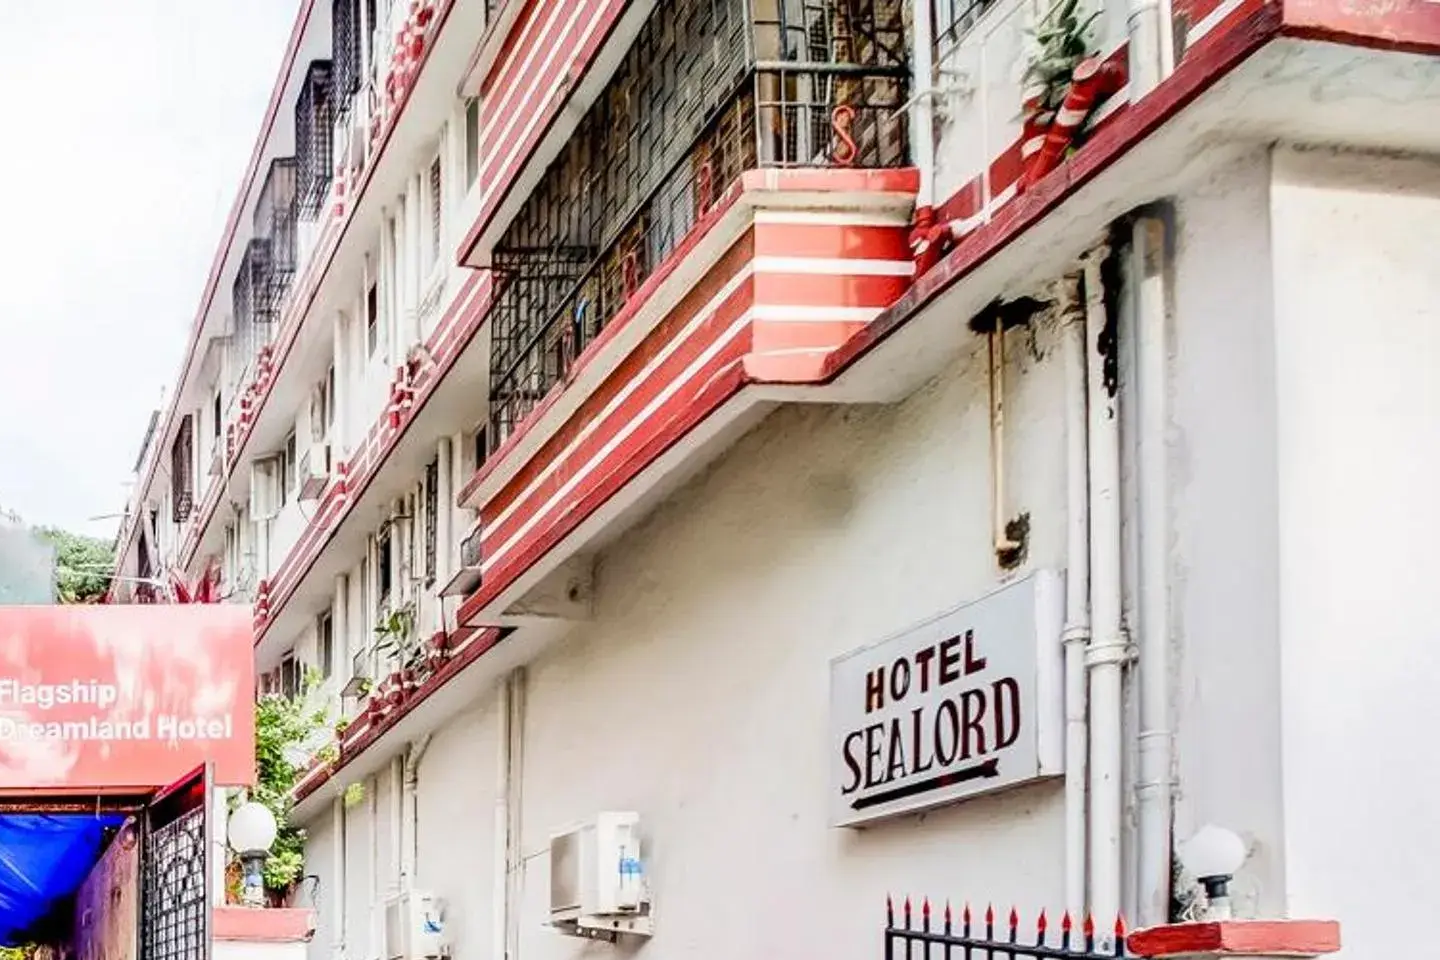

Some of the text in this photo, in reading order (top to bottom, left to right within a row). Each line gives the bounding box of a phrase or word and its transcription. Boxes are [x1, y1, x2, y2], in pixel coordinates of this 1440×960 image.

[865, 629, 986, 713] HOTEL
[157, 714, 233, 740] Hotel
[842, 676, 1020, 795] SEALORD
